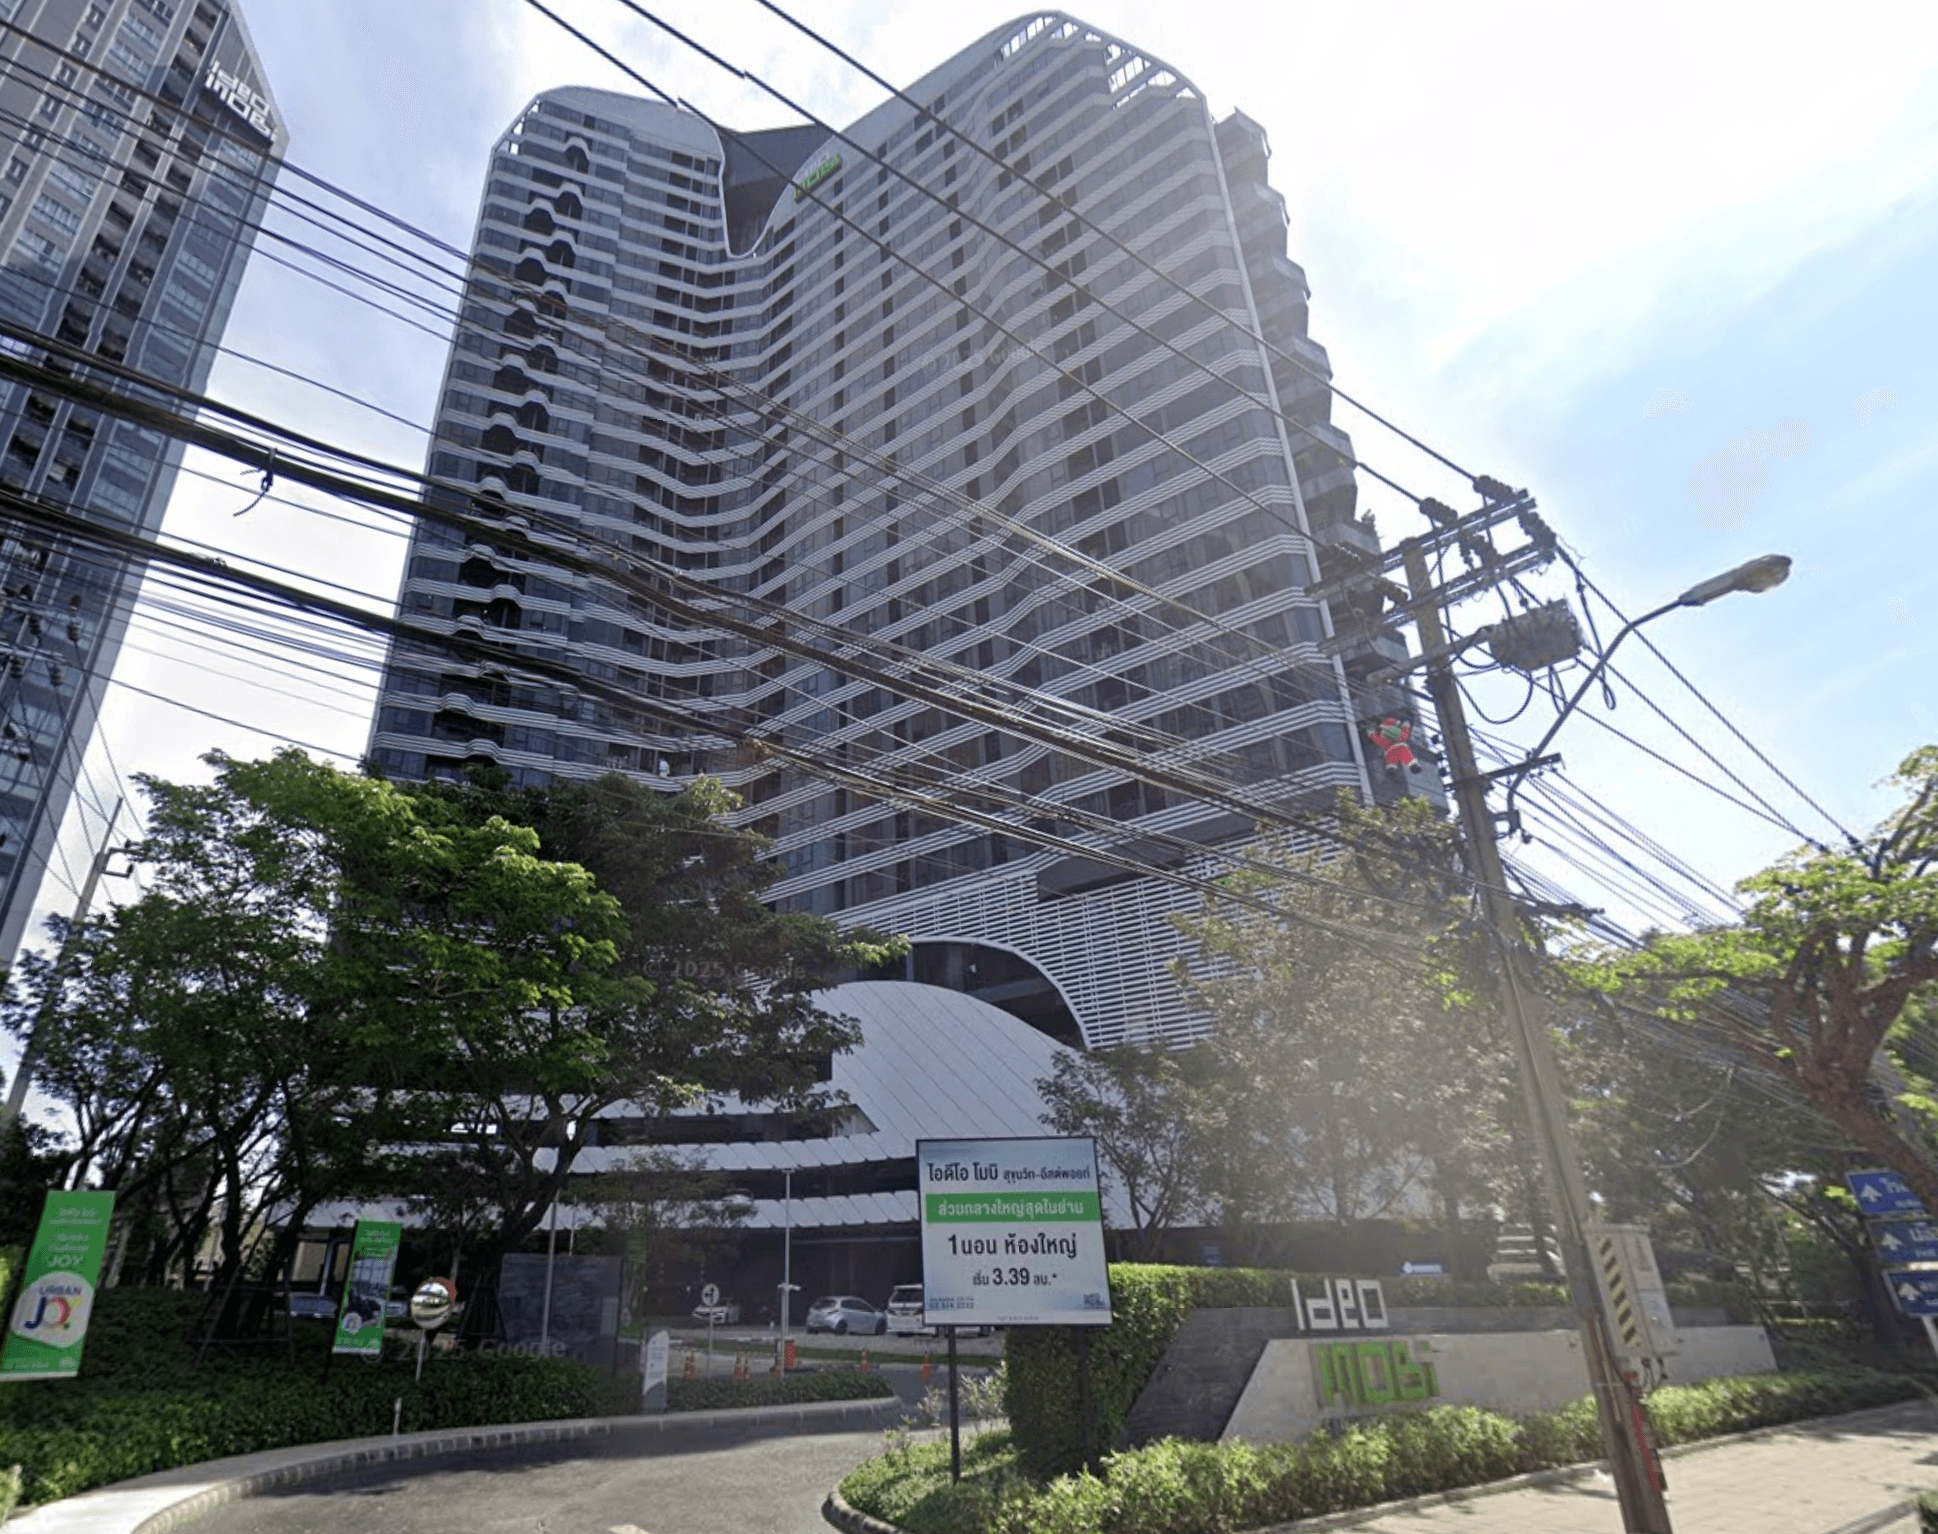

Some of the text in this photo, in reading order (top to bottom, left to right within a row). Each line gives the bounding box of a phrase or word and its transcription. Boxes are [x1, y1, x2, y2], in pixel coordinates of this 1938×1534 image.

[1005, 1233, 1078, 1259] ห้องใหญ่
[992, 1267, 1030, 1286] 3.39
